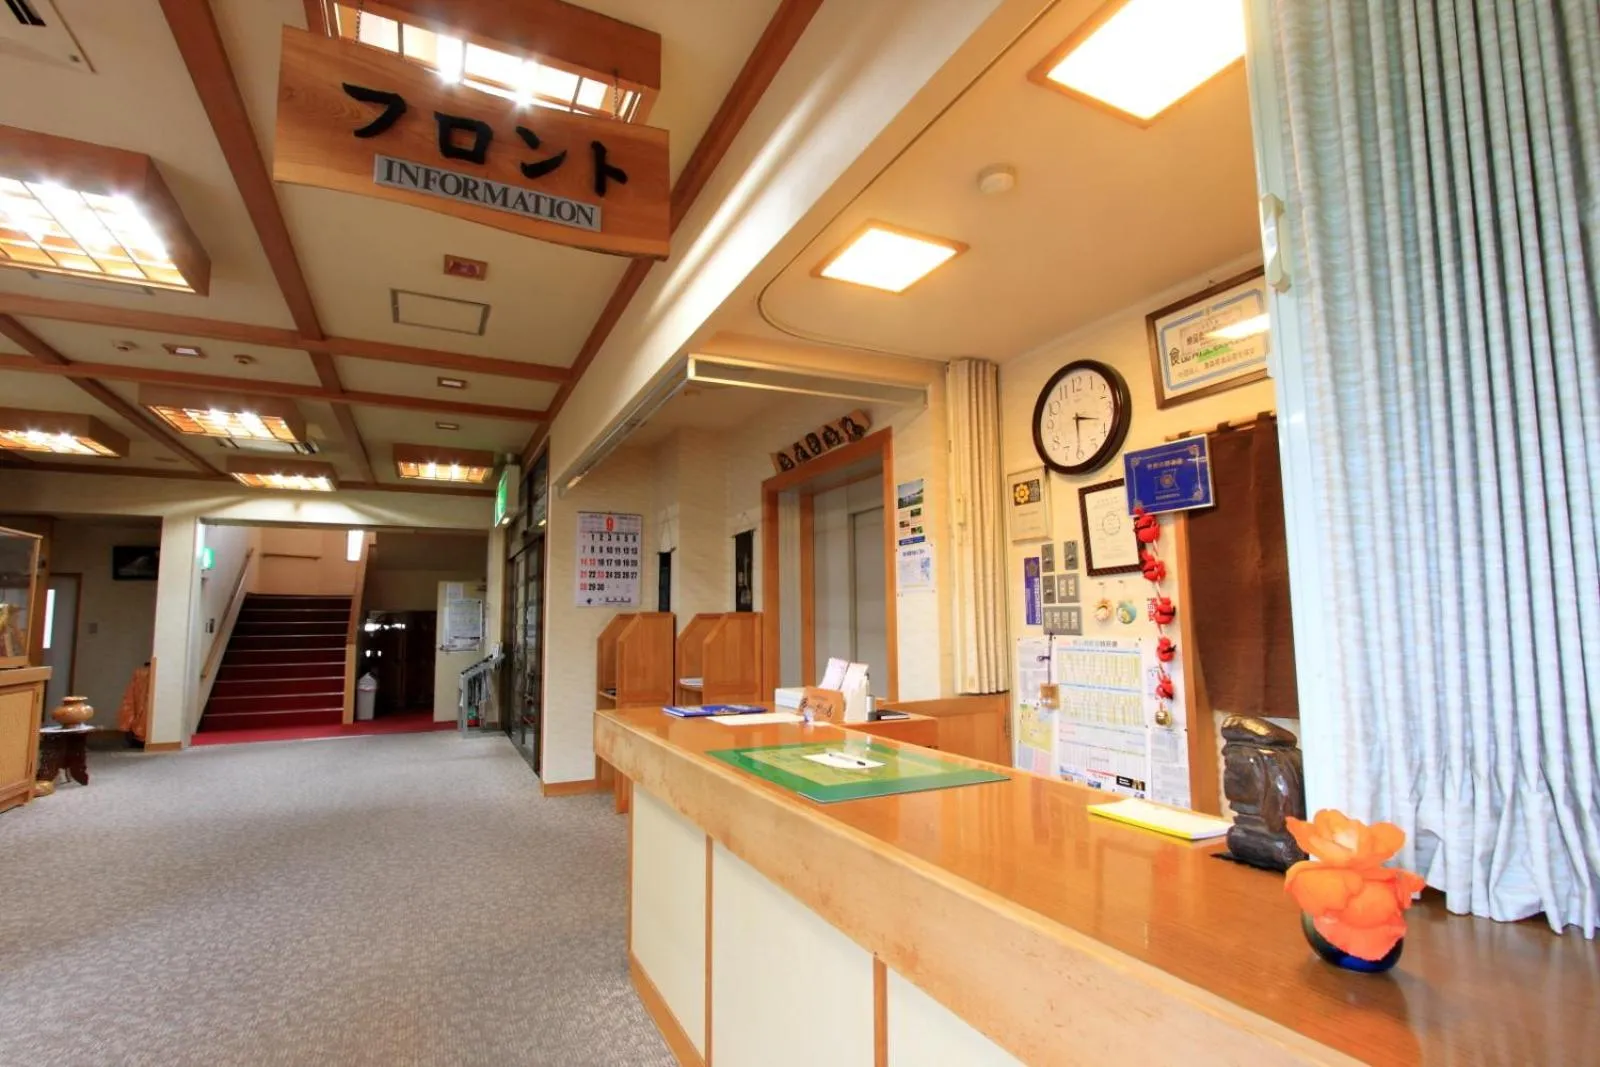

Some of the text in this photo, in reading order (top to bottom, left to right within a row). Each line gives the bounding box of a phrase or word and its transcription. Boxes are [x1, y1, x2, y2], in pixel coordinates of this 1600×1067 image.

[342, 82, 628, 196] フロント
[384, 158, 594, 226] INFORMATION
[1060, 385, 1068, 400] 11
[1072, 376, 1081, 393] 12
[1100, 384, 1107, 399] 2
[1100, 422, 1107, 438] 4
